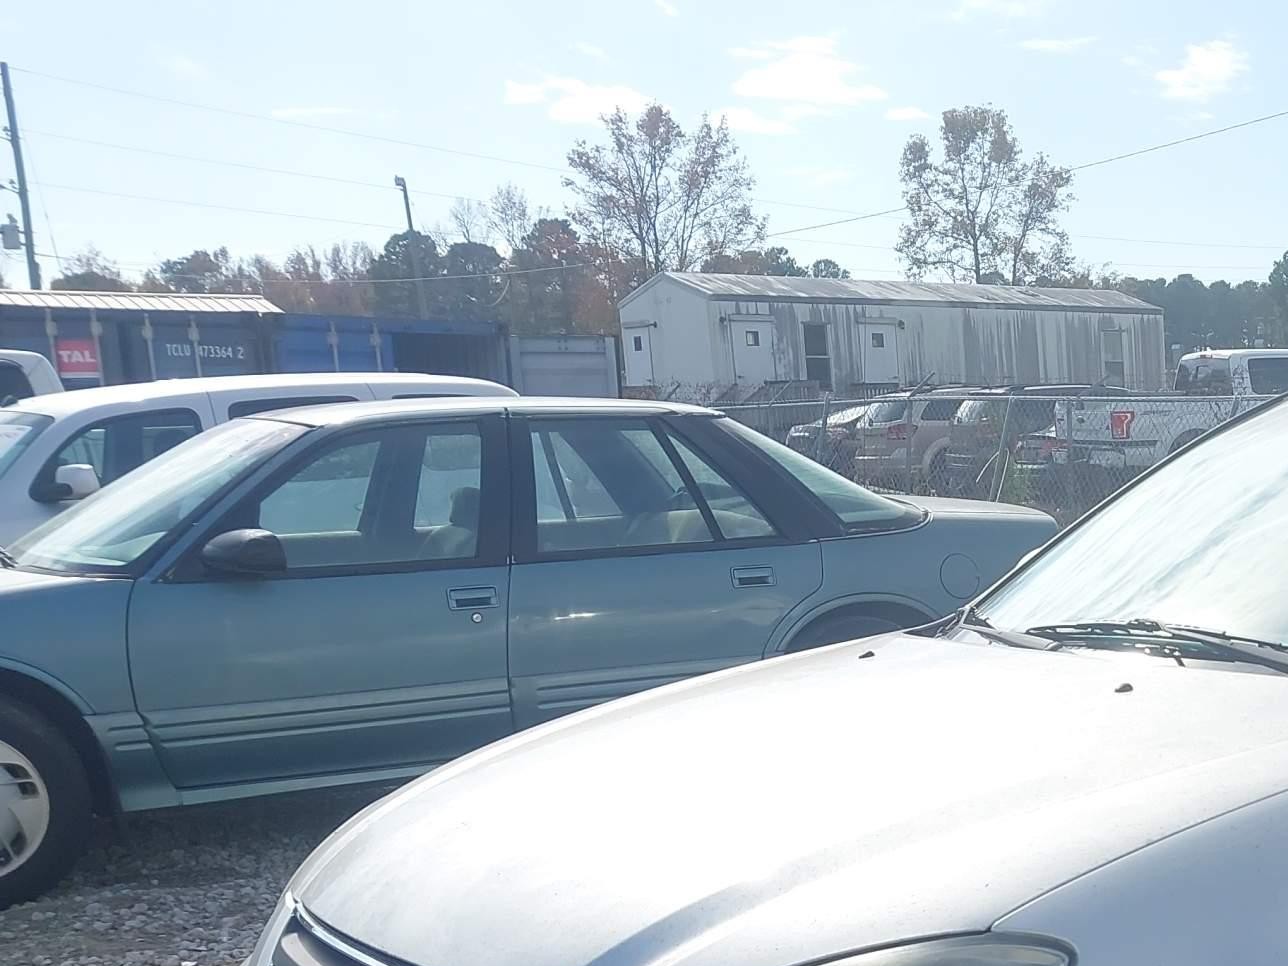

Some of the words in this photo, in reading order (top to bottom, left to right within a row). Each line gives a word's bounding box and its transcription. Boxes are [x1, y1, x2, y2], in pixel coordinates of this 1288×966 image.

[58, 350, 97, 363] TAL
[166, 343, 191, 356] TCLU
[237, 346, 244, 359] 2
